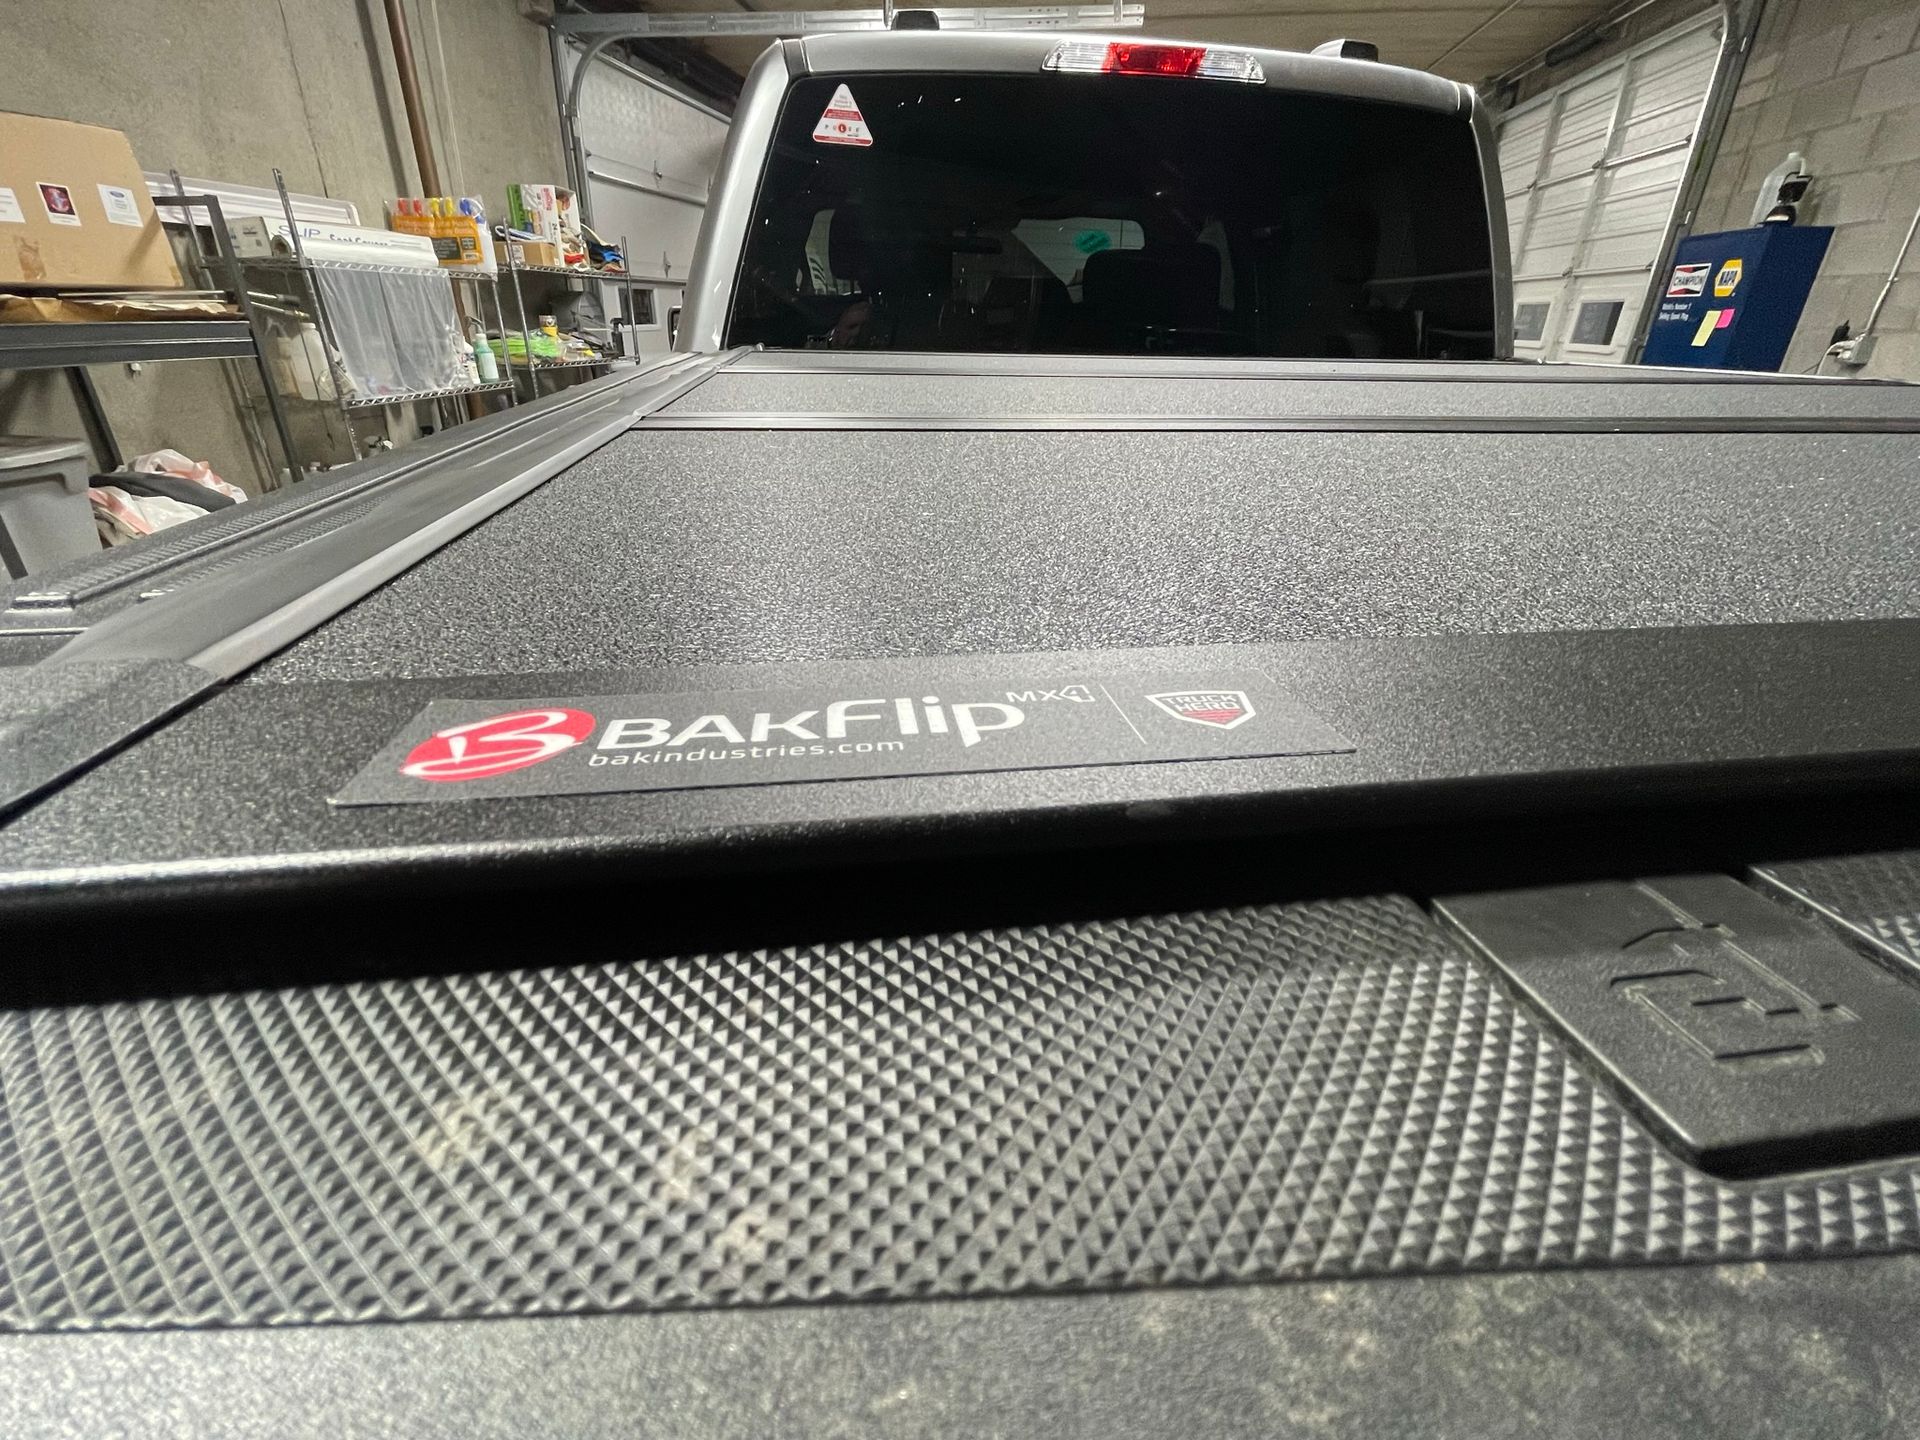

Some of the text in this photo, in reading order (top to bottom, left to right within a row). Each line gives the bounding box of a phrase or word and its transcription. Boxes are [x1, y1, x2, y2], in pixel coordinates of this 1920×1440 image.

[1674, 276, 1705, 286] CHAMPION
[1005, 684, 1096, 704] MX4
[1161, 694, 1238, 705] TRUCK
[1173, 701, 1241, 712] HERO
[588, 740, 905, 768] bakindustries.com
